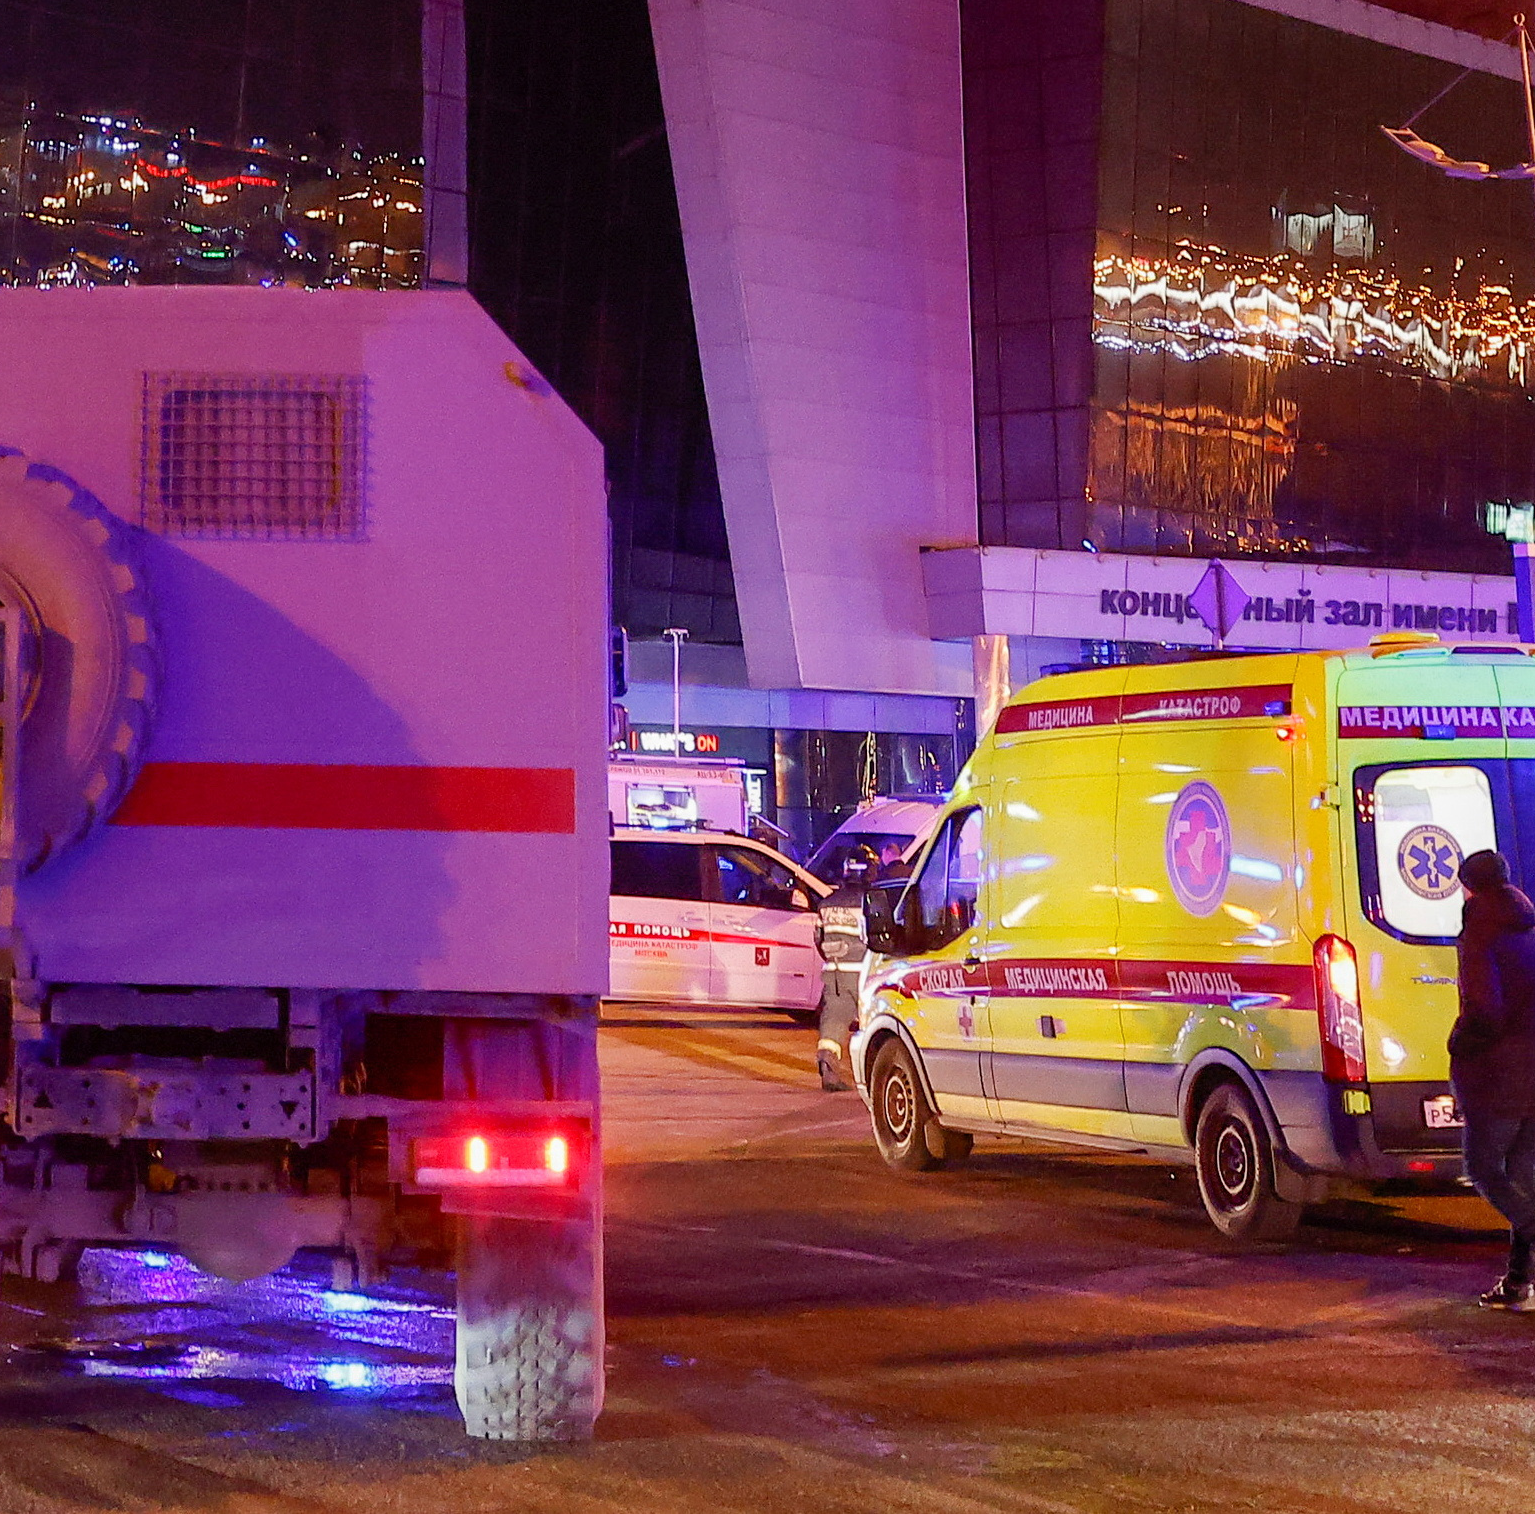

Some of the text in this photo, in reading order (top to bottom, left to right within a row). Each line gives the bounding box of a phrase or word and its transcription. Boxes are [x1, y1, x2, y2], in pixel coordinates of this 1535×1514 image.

[1101, 588, 1315, 624] конценый
[1324, 600, 1383, 628] зал
[1392, 602, 1498, 634] имени
[1028, 695, 1241, 730] МЕДИЦИНА КАТАСТРОФ
[1339, 707, 1498, 730] МЕДИЦИНА
[697, 735, 717, 752] ON
[634, 924, 691, 938] ПОМОЩЬ
[919, 967, 1242, 1001] СКОРАЯ МЕДИЦИНСКАЯ ПОМОЩЬ
